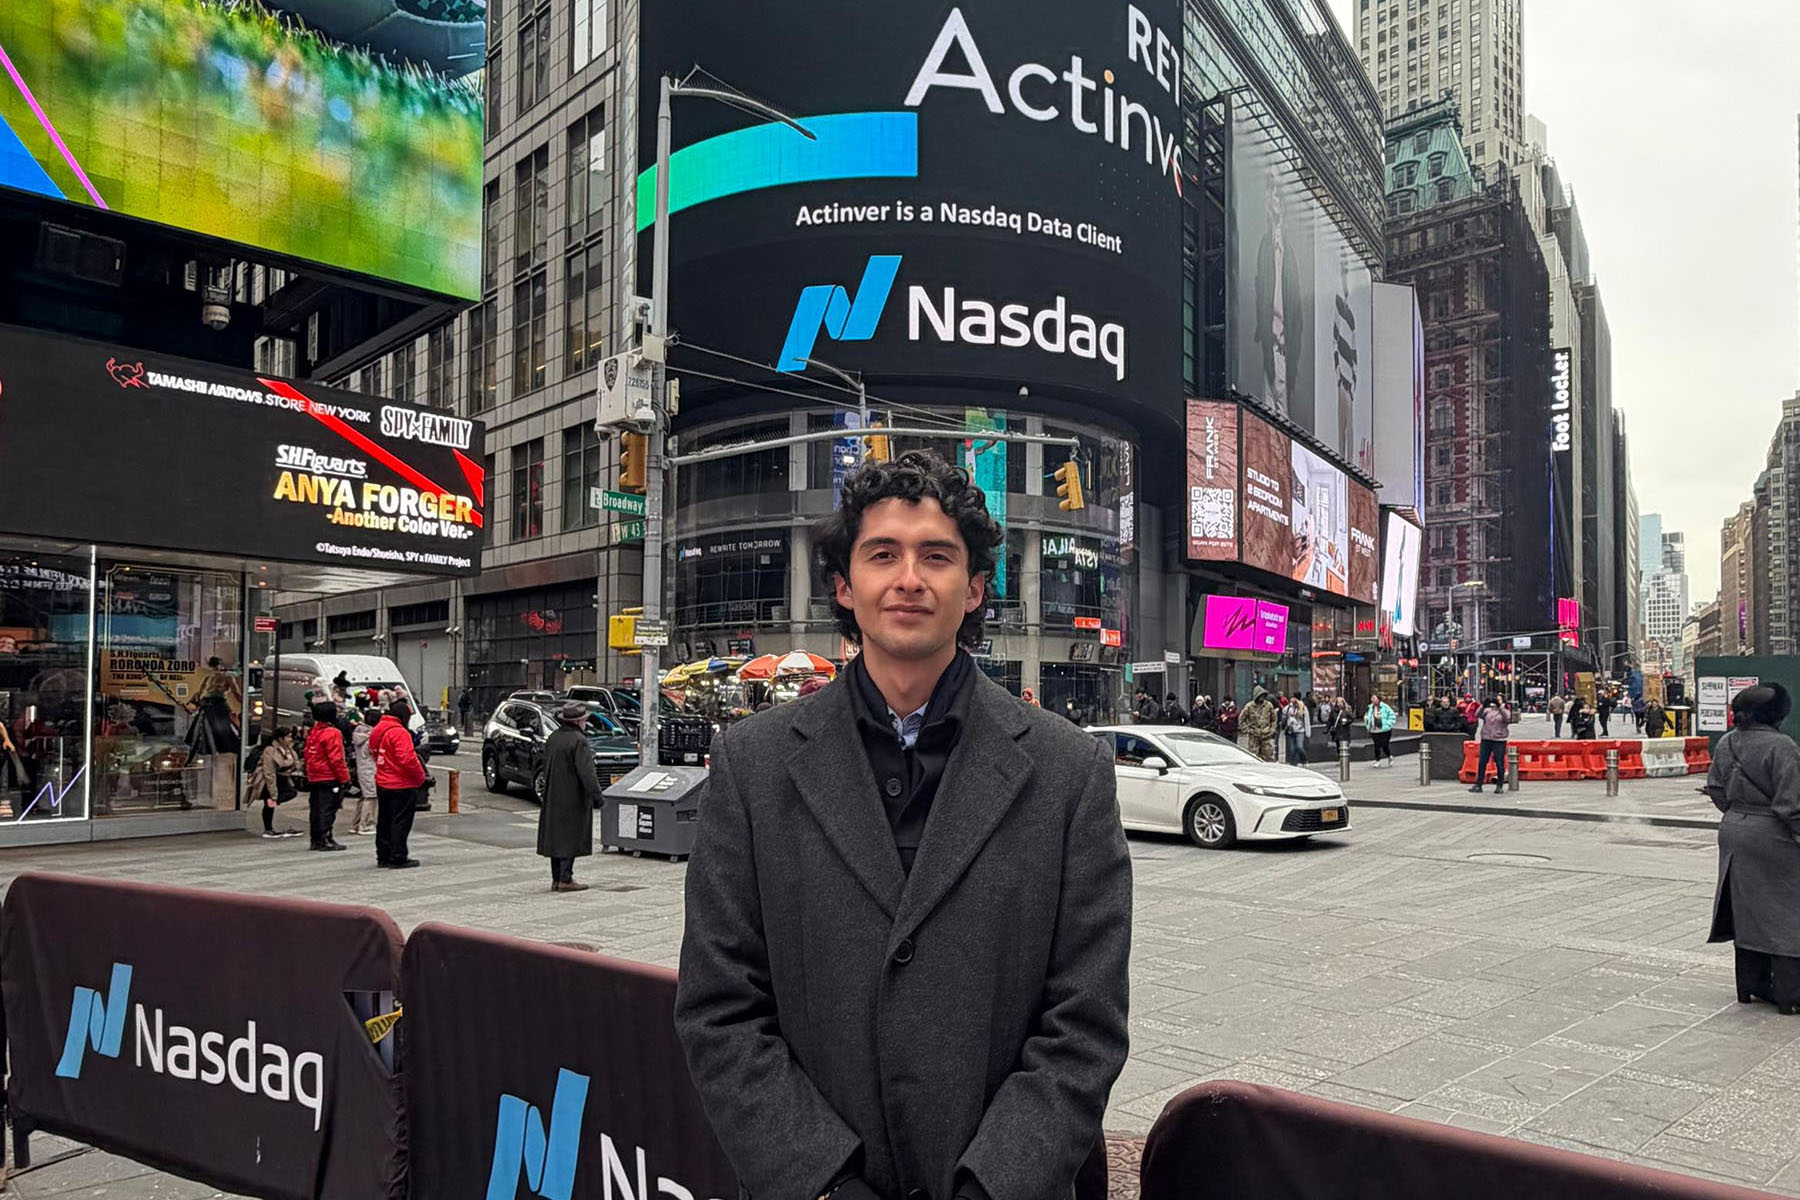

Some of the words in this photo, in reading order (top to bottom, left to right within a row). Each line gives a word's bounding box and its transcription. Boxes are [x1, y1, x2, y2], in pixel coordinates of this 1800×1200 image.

[795, 202, 890, 226] Actinver
[896, 200, 914, 221] is
[920, 205, 933, 222] a
[940, 202, 1022, 234] Nasdaq
[1027, 211, 1072, 239] Data
[1077, 222, 1122, 254] Client
[908, 285, 1125, 382] Nasdaq
[147, 371, 208, 394] TAMASHII
[309, 401, 338, 417] NEW
[338, 406, 371, 423] YORK
[1552, 412, 1570, 452] Foot
[1206, 416, 1214, 479] FRANK
[273, 471, 356, 509] ANYA
[362, 482, 473, 523] FORGER
[1271, 479, 1280, 492] TO
[603, 492, 643, 515] Broadway
[1247, 500, 1289, 526] APARTMENTS
[398, 515, 439, 536] Color
[621, 524, 628, 539] W
[631, 522, 641, 537] 43
[709, 543, 736, 553] REWRITE
[739, 539, 781, 551] TOMORROW
[1351, 527, 1375, 551] FRANK
[406, 551, 419, 562] SPY
[448, 555, 471, 568] Project
[110, 659, 165, 670] RORONOA
[168, 660, 195, 671] ZORO
[134, 1003, 324, 1132] Nasdaq
